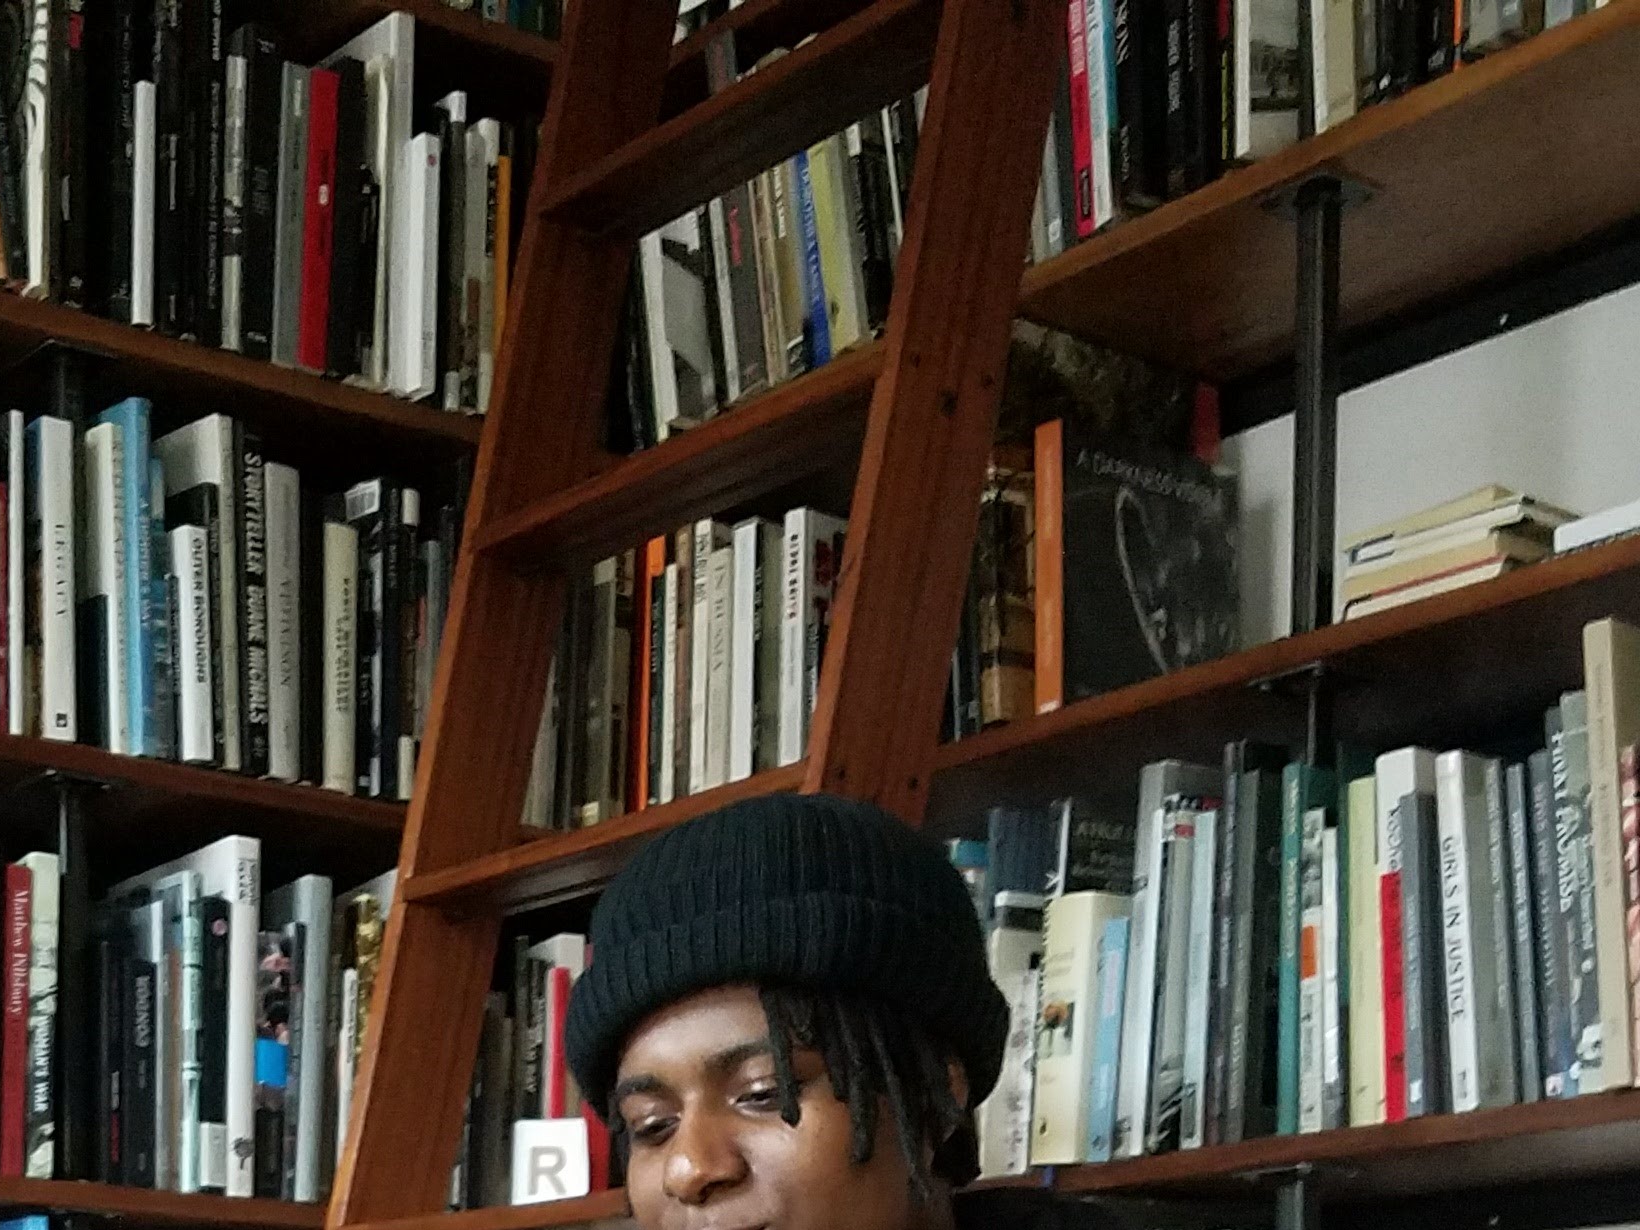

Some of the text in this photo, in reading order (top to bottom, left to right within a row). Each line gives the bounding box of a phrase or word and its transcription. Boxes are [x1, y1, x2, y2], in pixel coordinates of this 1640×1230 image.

[243, 452, 266, 576] STORYTELLER
[192, 536, 207, 591] OUTER
[248, 645, 269, 725] MICHALS
[1442, 835, 1466, 1026] GIRLS IN JUSTICE
[527, 1145, 568, 1197] R
